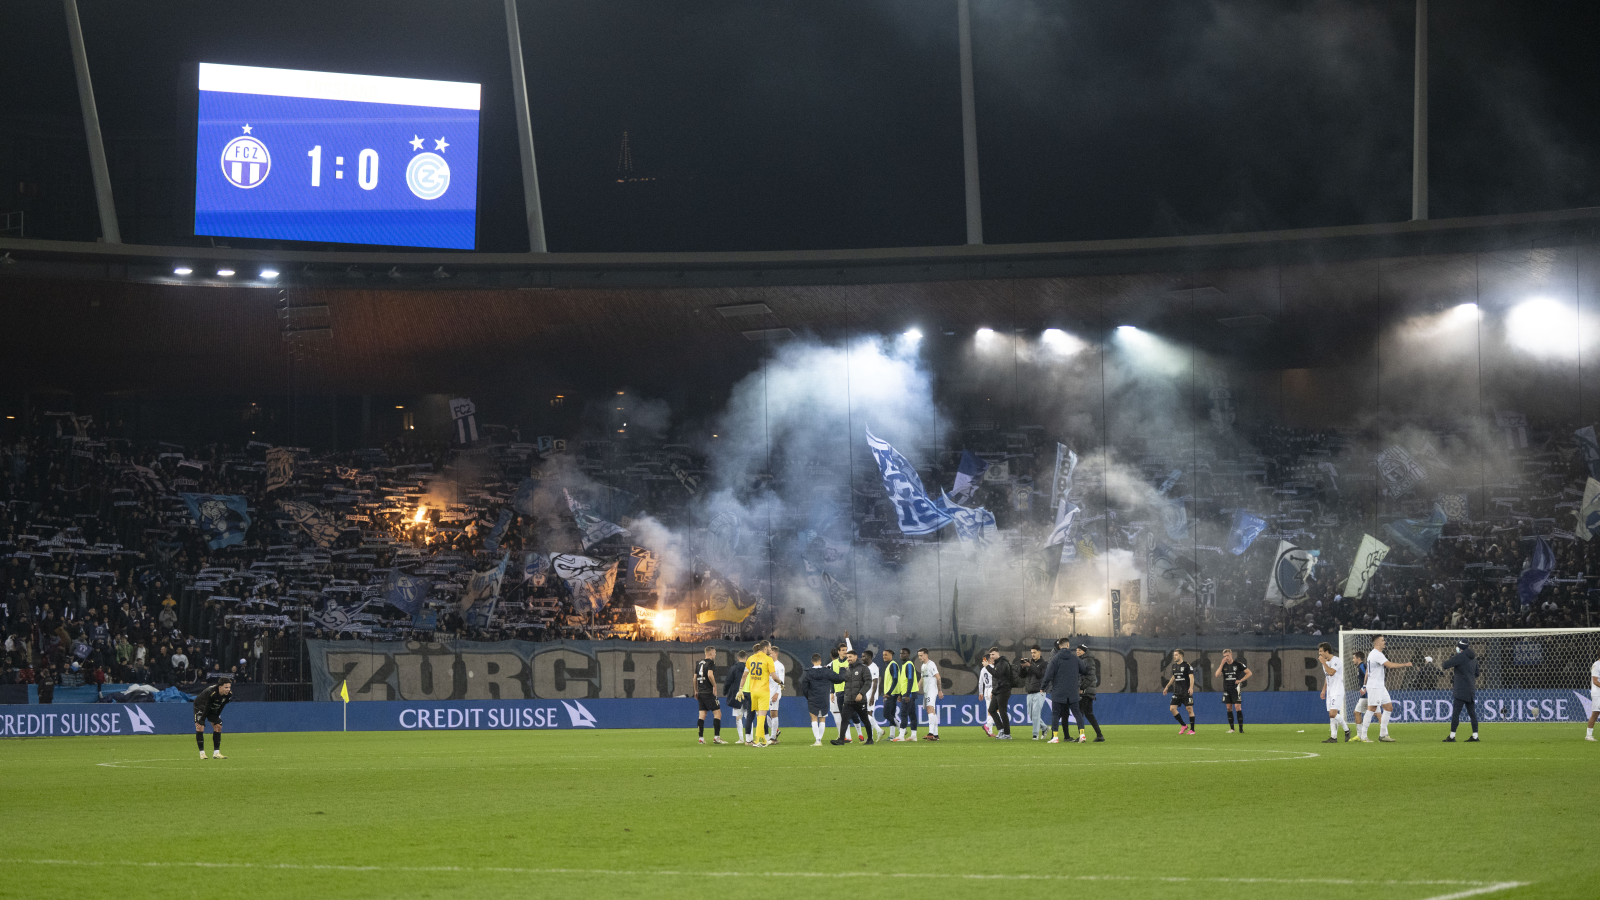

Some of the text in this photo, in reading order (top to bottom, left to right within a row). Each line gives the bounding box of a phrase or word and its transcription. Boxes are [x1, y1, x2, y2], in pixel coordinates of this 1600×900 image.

[234, 145, 259, 160] FCZ
[750, 661, 763, 676] 25
[399, 707, 558, 729] CREDIT SUISSE
[1389, 699, 1569, 721] CRED SUISSE
[0, 712, 121, 736] REDIT SUISSE
